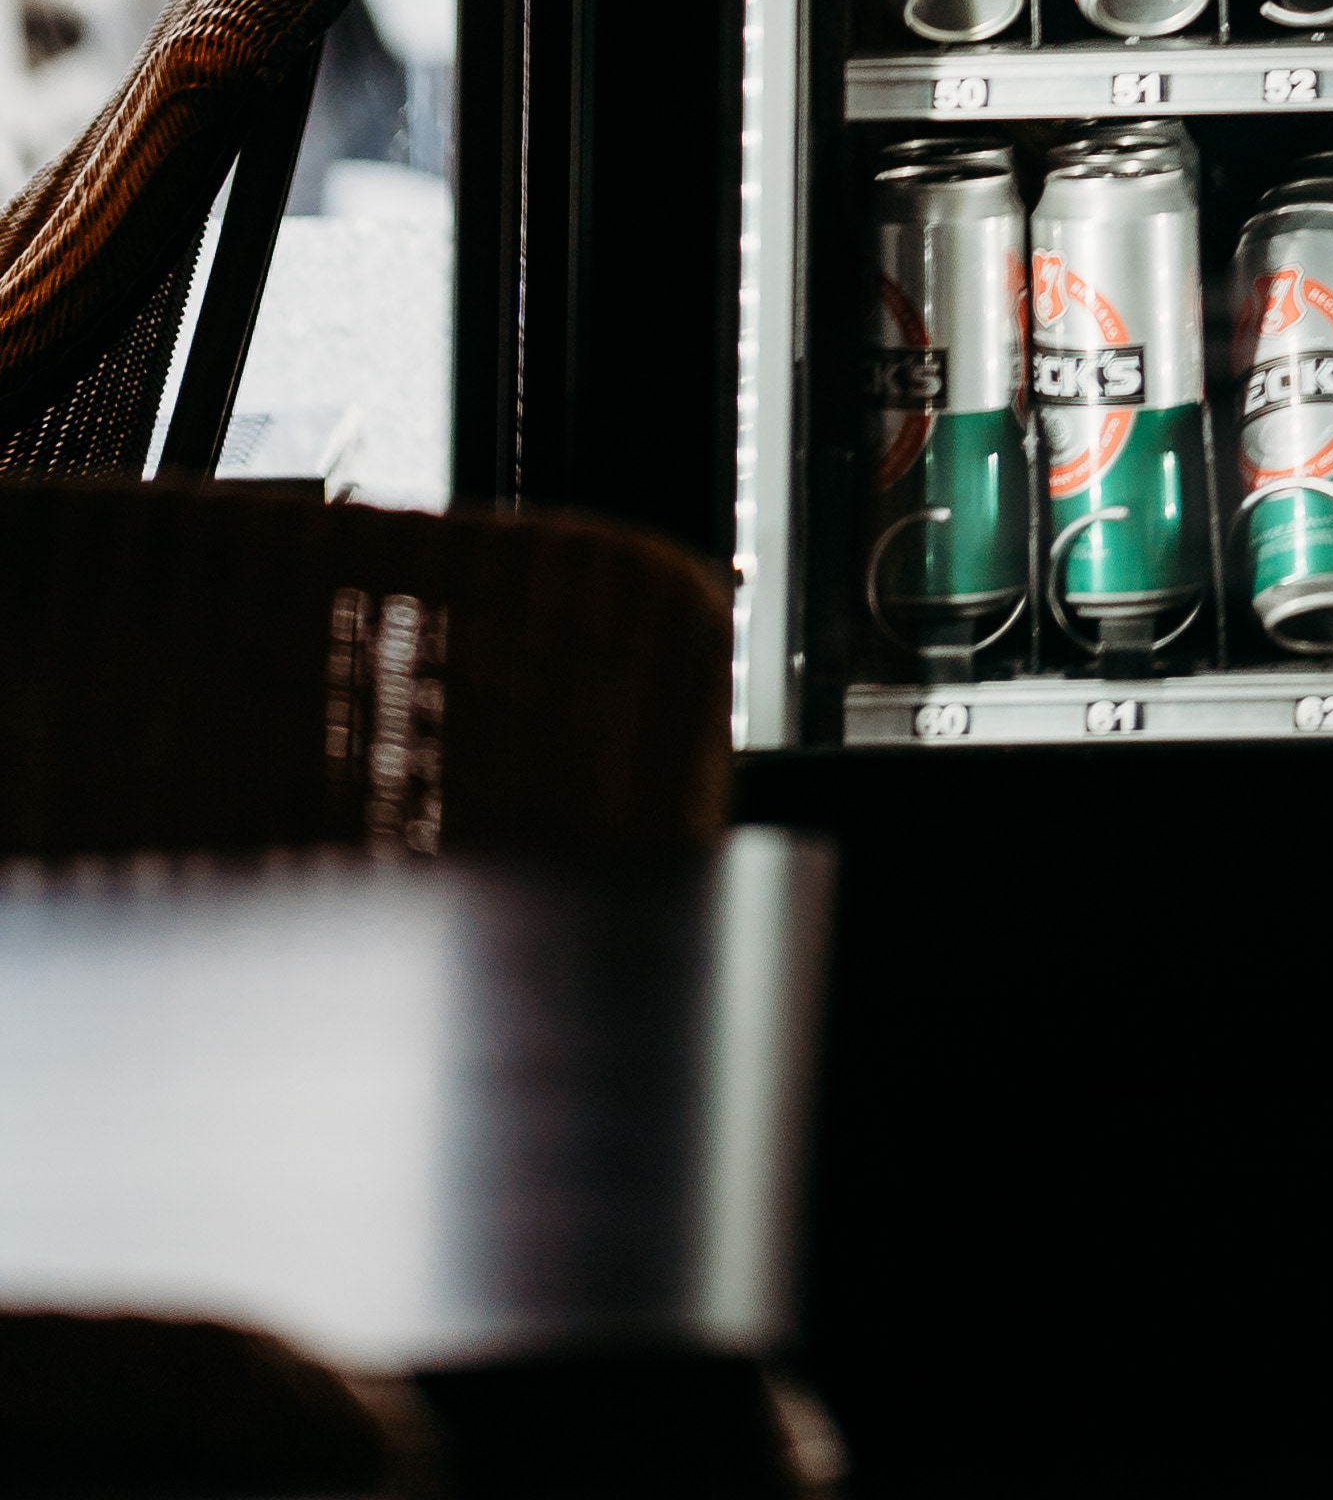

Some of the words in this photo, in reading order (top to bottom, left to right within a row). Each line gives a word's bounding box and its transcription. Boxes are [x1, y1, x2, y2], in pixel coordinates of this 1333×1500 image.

[932, 78, 989, 108] 50
[1112, 73, 1164, 105] 51
[1263, 70, 1318, 103] 52
[915, 706, 969, 737] 60
[1085, 701, 1137, 732] 61
